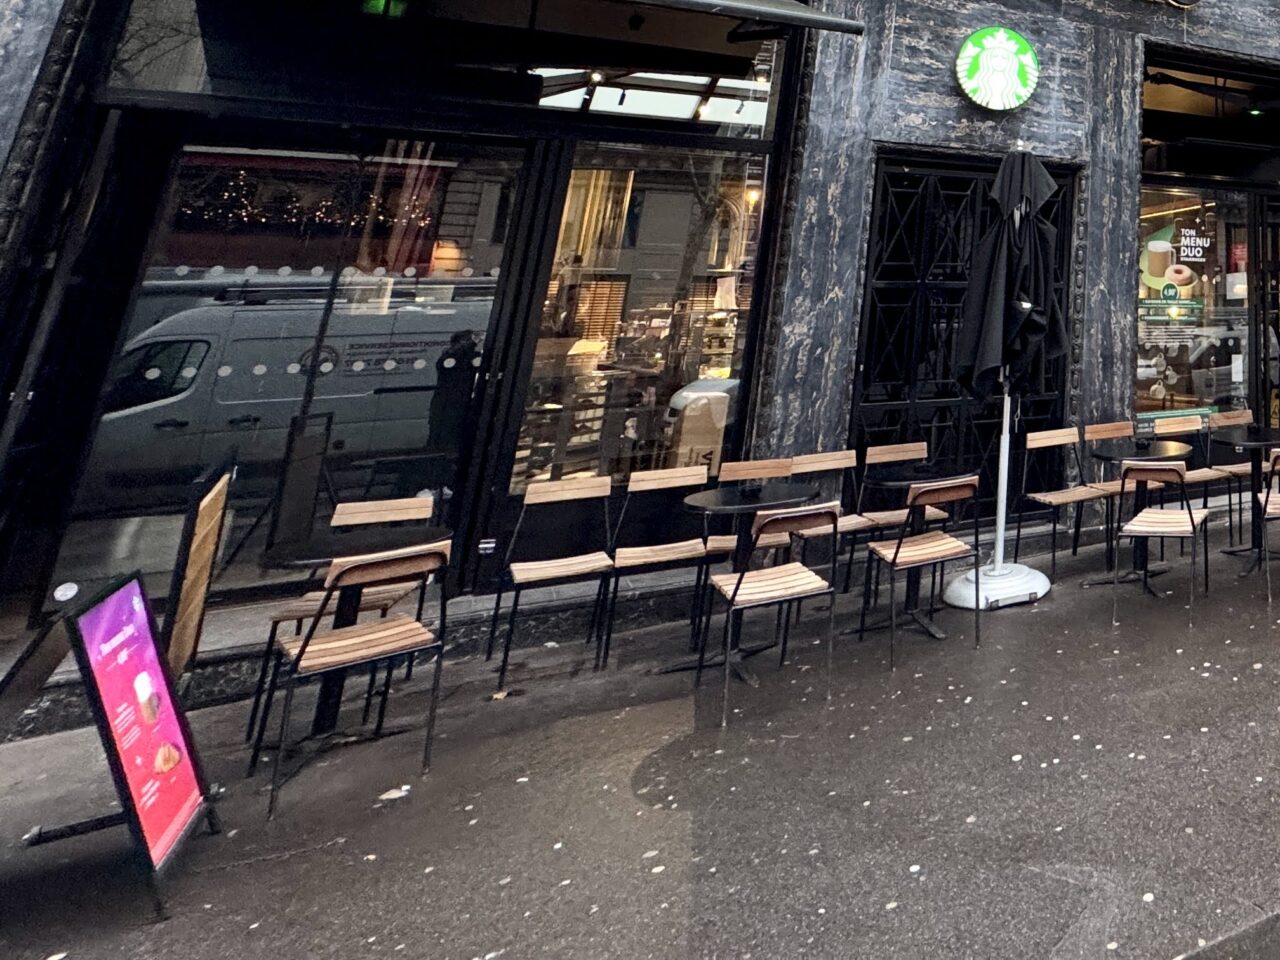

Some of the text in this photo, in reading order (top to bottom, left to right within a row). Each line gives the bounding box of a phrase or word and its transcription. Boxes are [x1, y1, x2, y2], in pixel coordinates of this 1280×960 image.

[1181, 228, 1196, 237] TON
[1180, 236, 1210, 248] MENU
[1180, 247, 1203, 257] DUO
